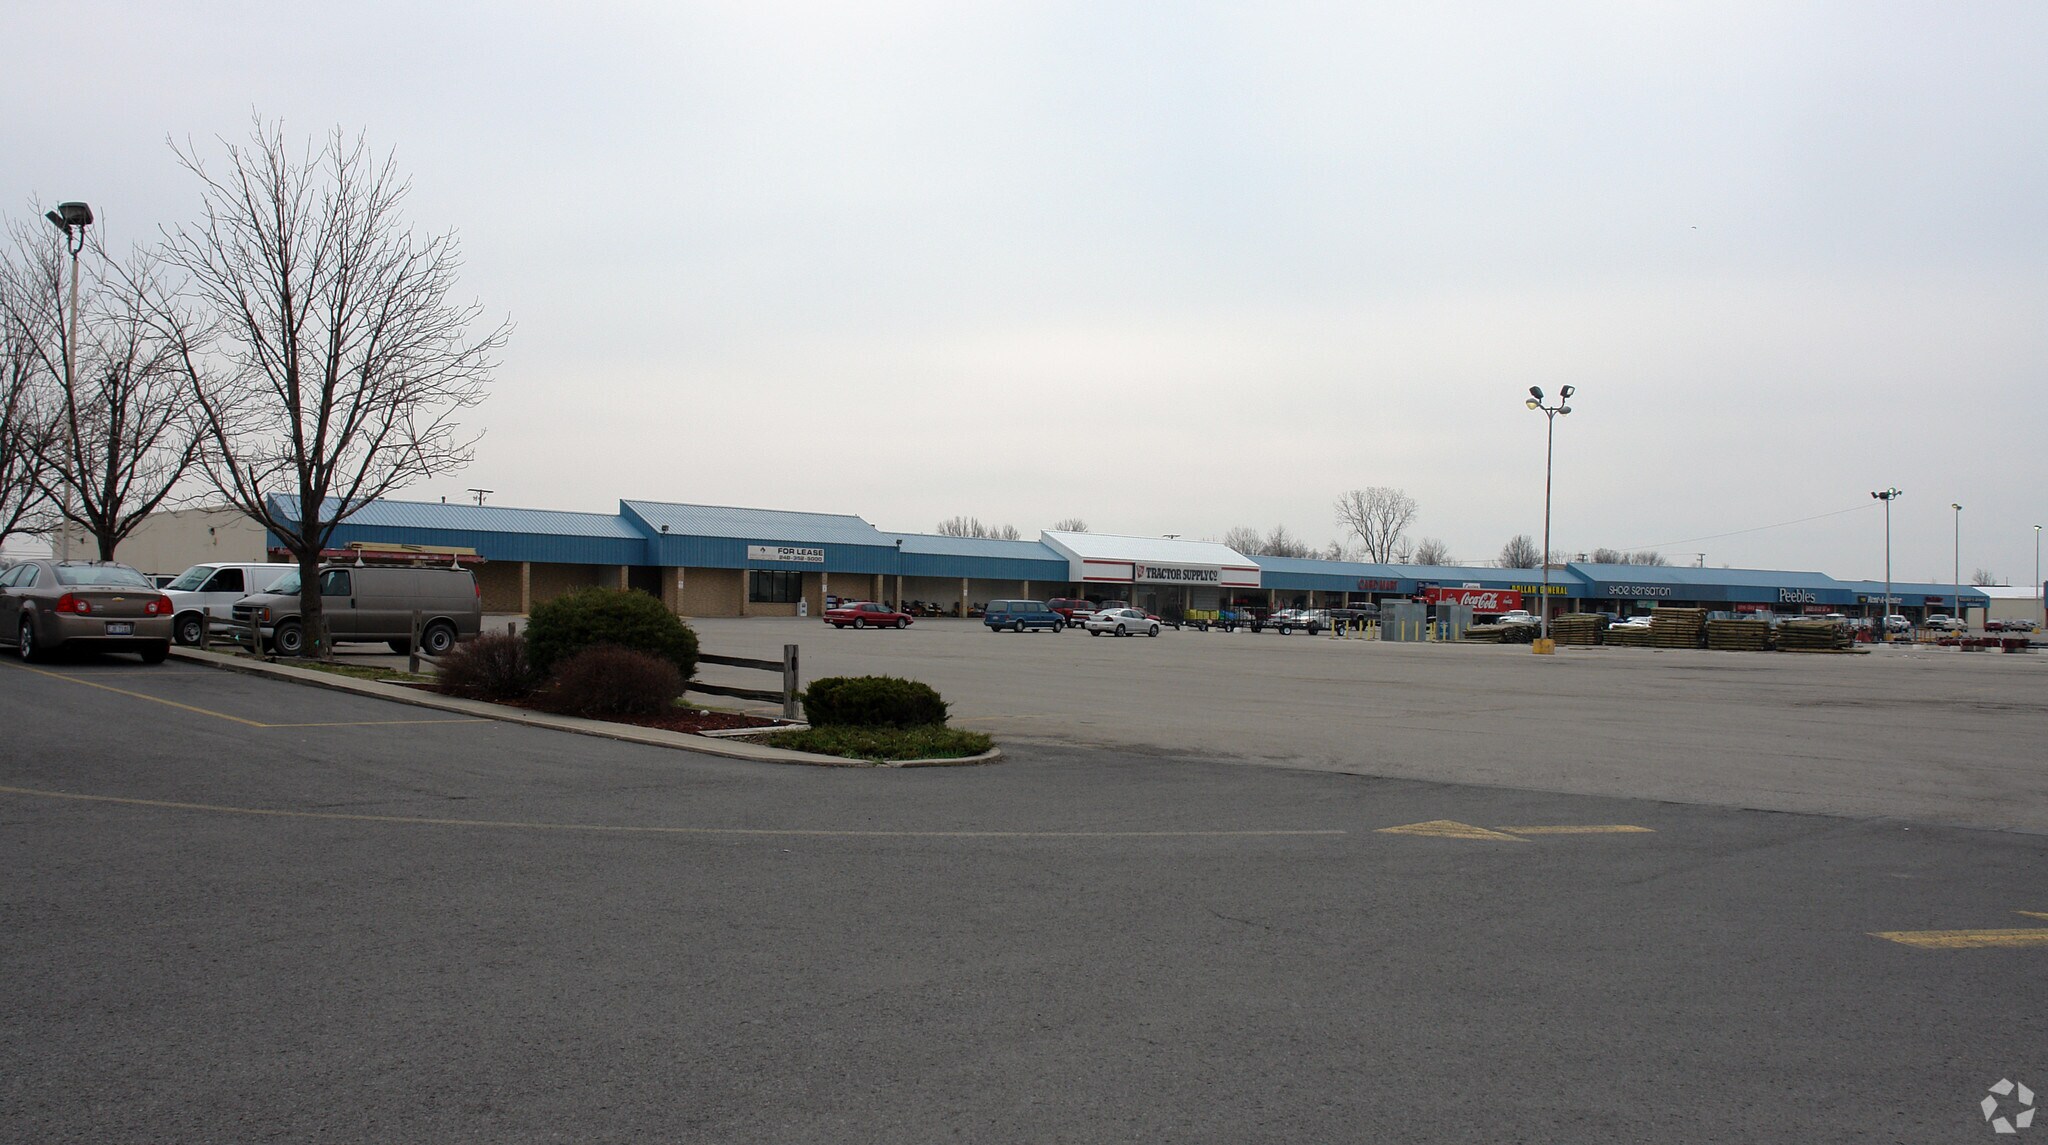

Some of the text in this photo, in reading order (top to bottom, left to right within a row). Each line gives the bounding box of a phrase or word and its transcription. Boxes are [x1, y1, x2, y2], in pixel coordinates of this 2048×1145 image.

[1146, 567, 1182, 580] TRACTOR
[1182, 569, 1209, 581] SUPPLY
[1539, 586, 1568, 595] GNERAL
[1779, 588, 1816, 603] Peebles
[1867, 595, 1902, 604] Rent-A-enter
